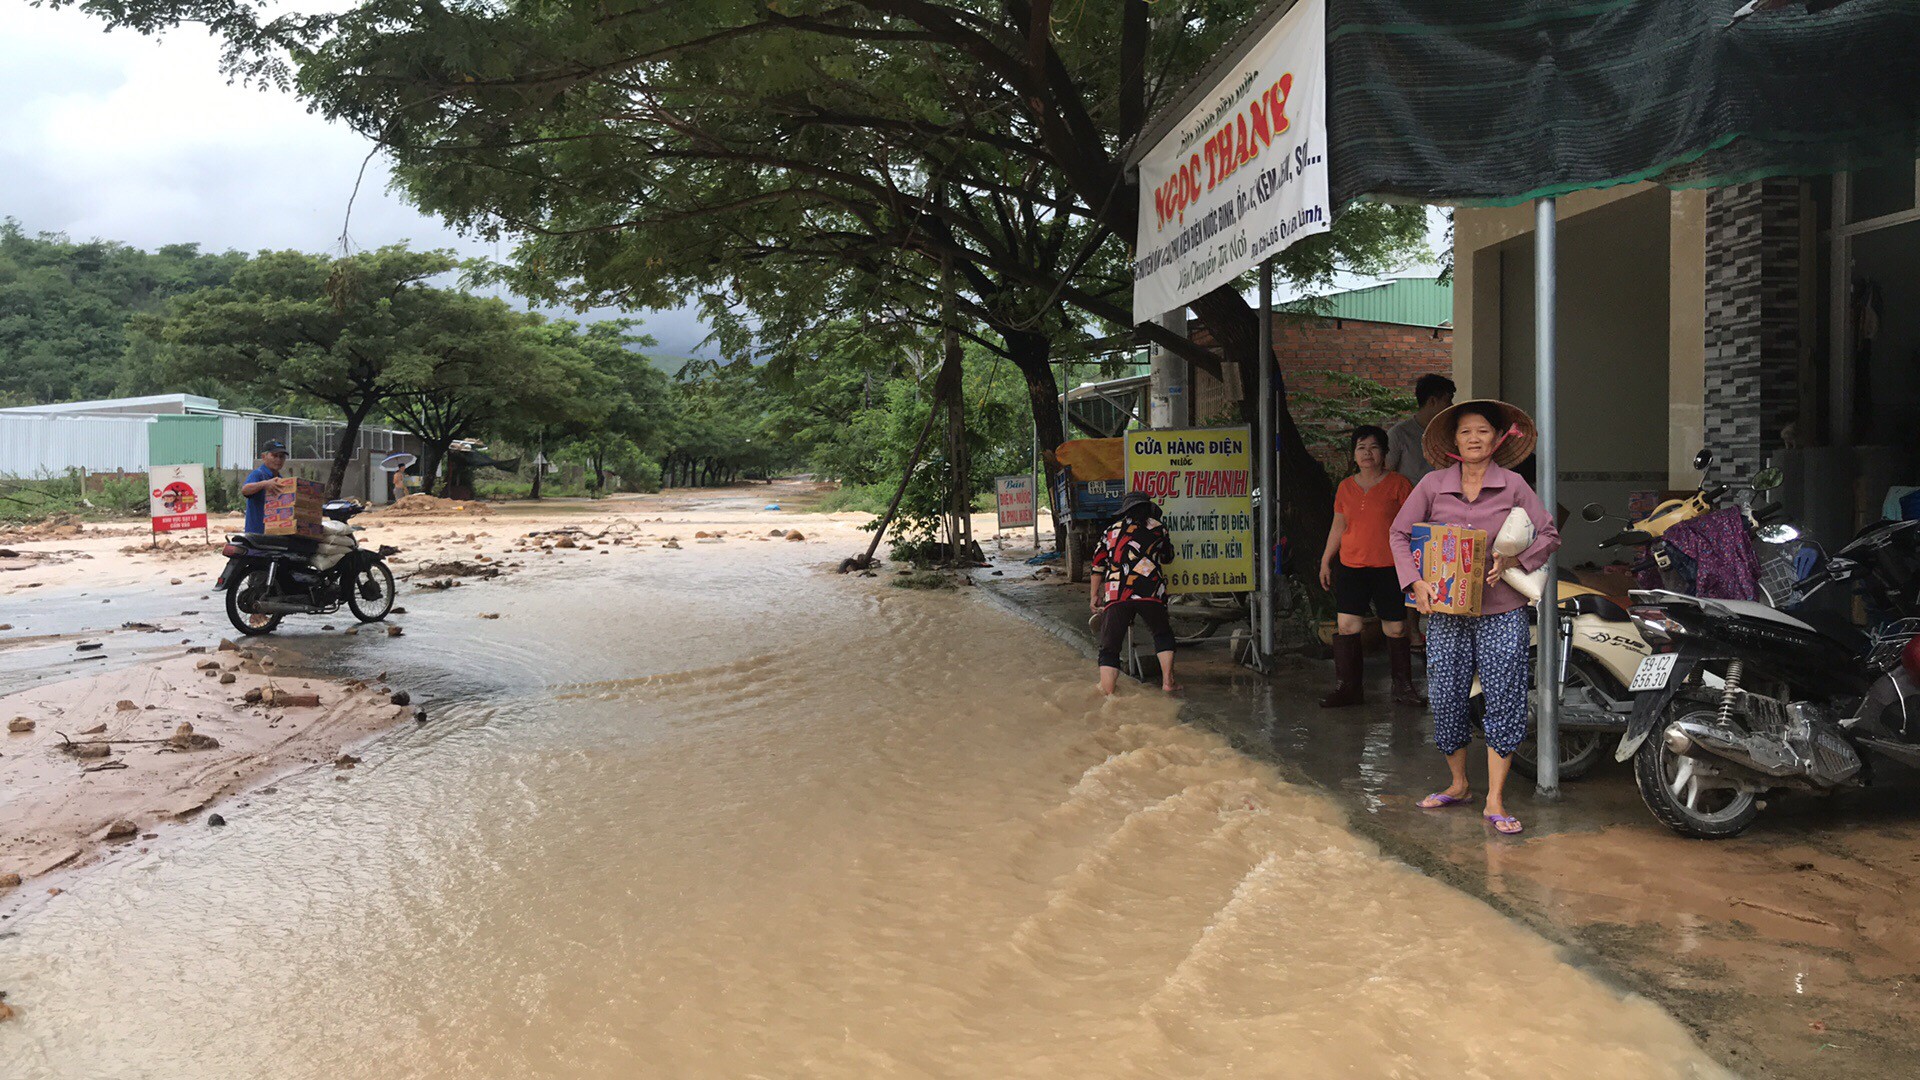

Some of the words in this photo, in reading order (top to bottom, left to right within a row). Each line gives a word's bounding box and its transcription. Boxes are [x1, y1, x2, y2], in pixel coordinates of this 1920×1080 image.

[1154, 152, 1201, 233] NGỌC
[1135, 437, 1162, 455] CỬA
[1167, 438, 1205, 455] HÀNG
[1209, 438, 1243, 457] ĐIỆN
[1132, 471, 1180, 505] NGỌC
[1184, 470, 1248, 498] THANH
[1180, 511, 1195, 531] CÁC
[1197, 509, 1219, 531] THIẾT
[1221, 514, 1230, 534] BỊ
[1231, 510, 1250, 533] ĐIỆN
[1172, 573, 1179, 585] 6
[1193, 573, 1200, 585] 6
[1202, 571, 1220, 585] Đất
[1223, 572, 1247, 585] Lành
[1632, 672, 1667, 689] 656.30
